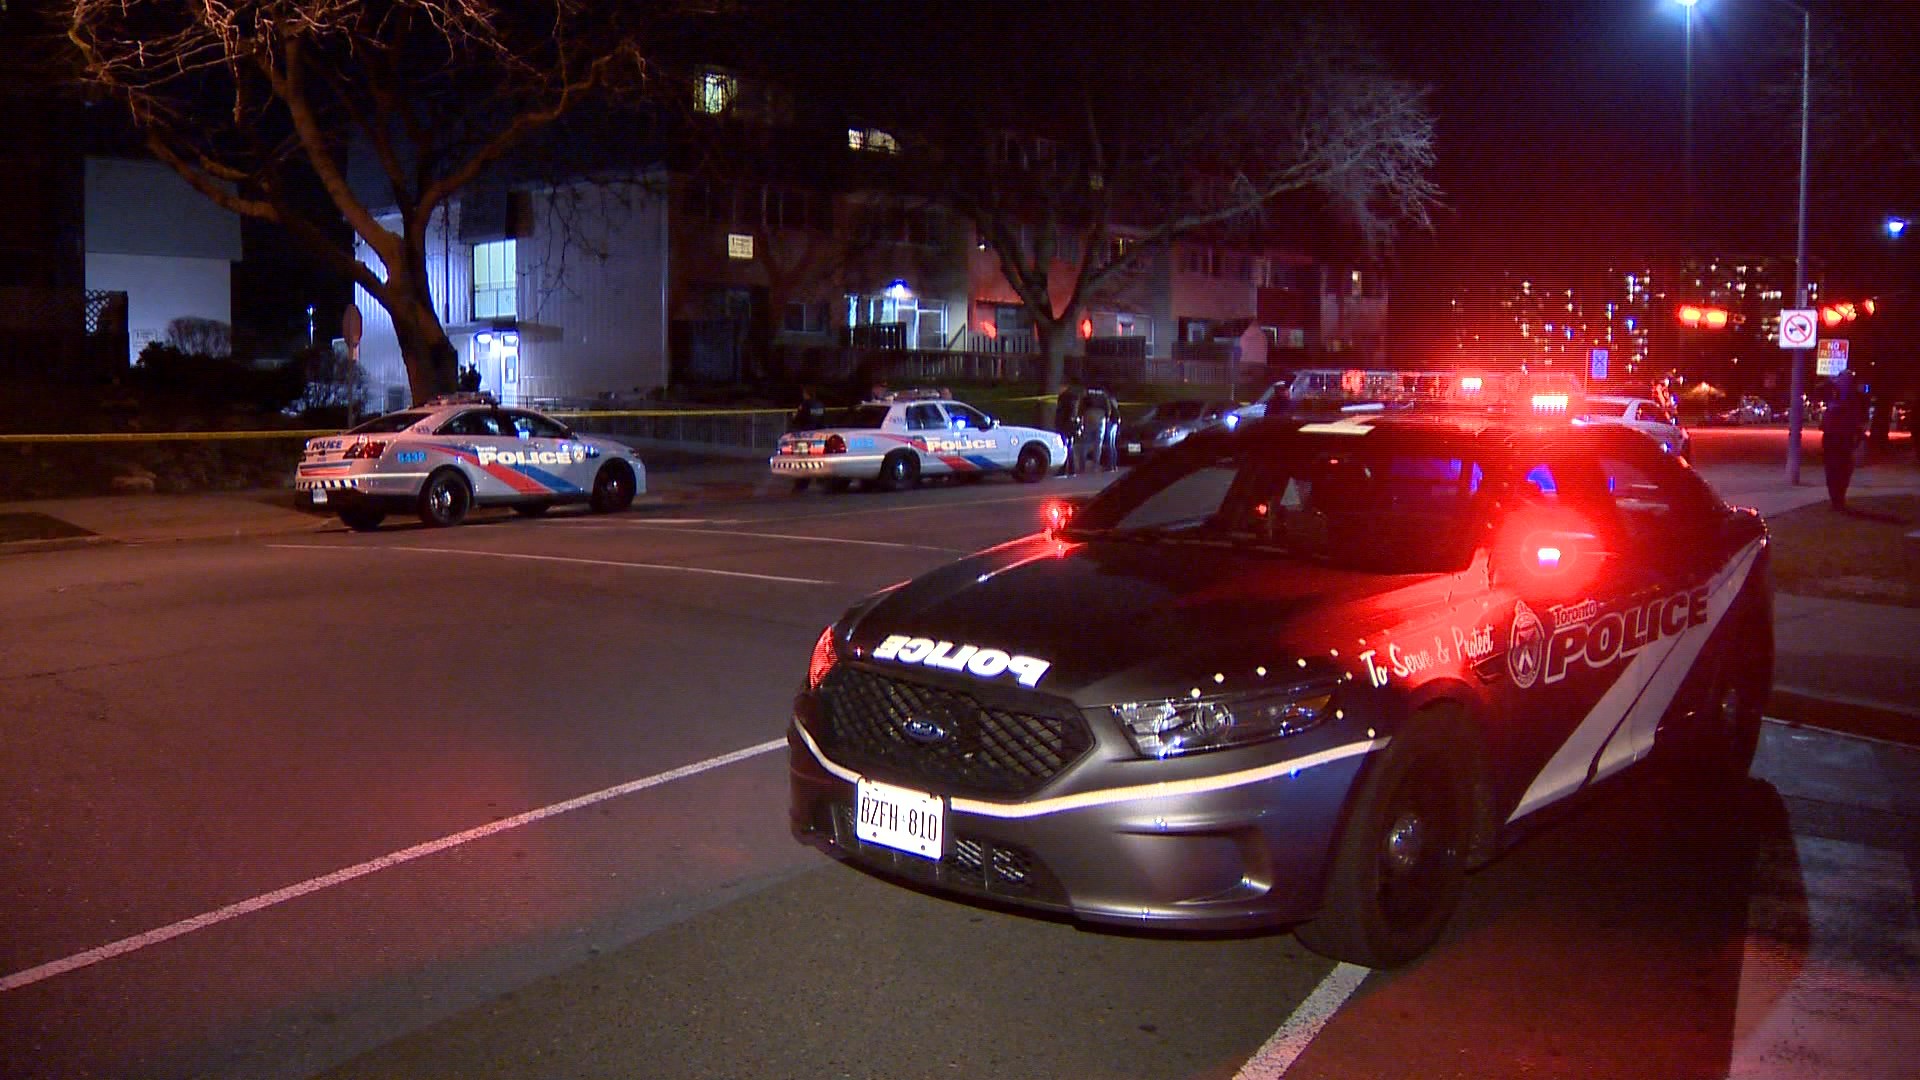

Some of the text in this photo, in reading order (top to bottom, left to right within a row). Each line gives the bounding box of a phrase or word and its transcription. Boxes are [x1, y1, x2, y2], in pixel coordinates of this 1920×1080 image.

[1828, 342, 1840, 350] NO
[312, 440, 342, 450] POLICE
[927, 439, 996, 451] POLICE
[479, 451, 572, 464] POLICE
[1552, 600, 1597, 627] Toronto
[1545, 586, 1710, 684] POLICE
[1360, 625, 1494, 688] To Serve & Protect
[861, 796, 937, 842] BZFH 810
